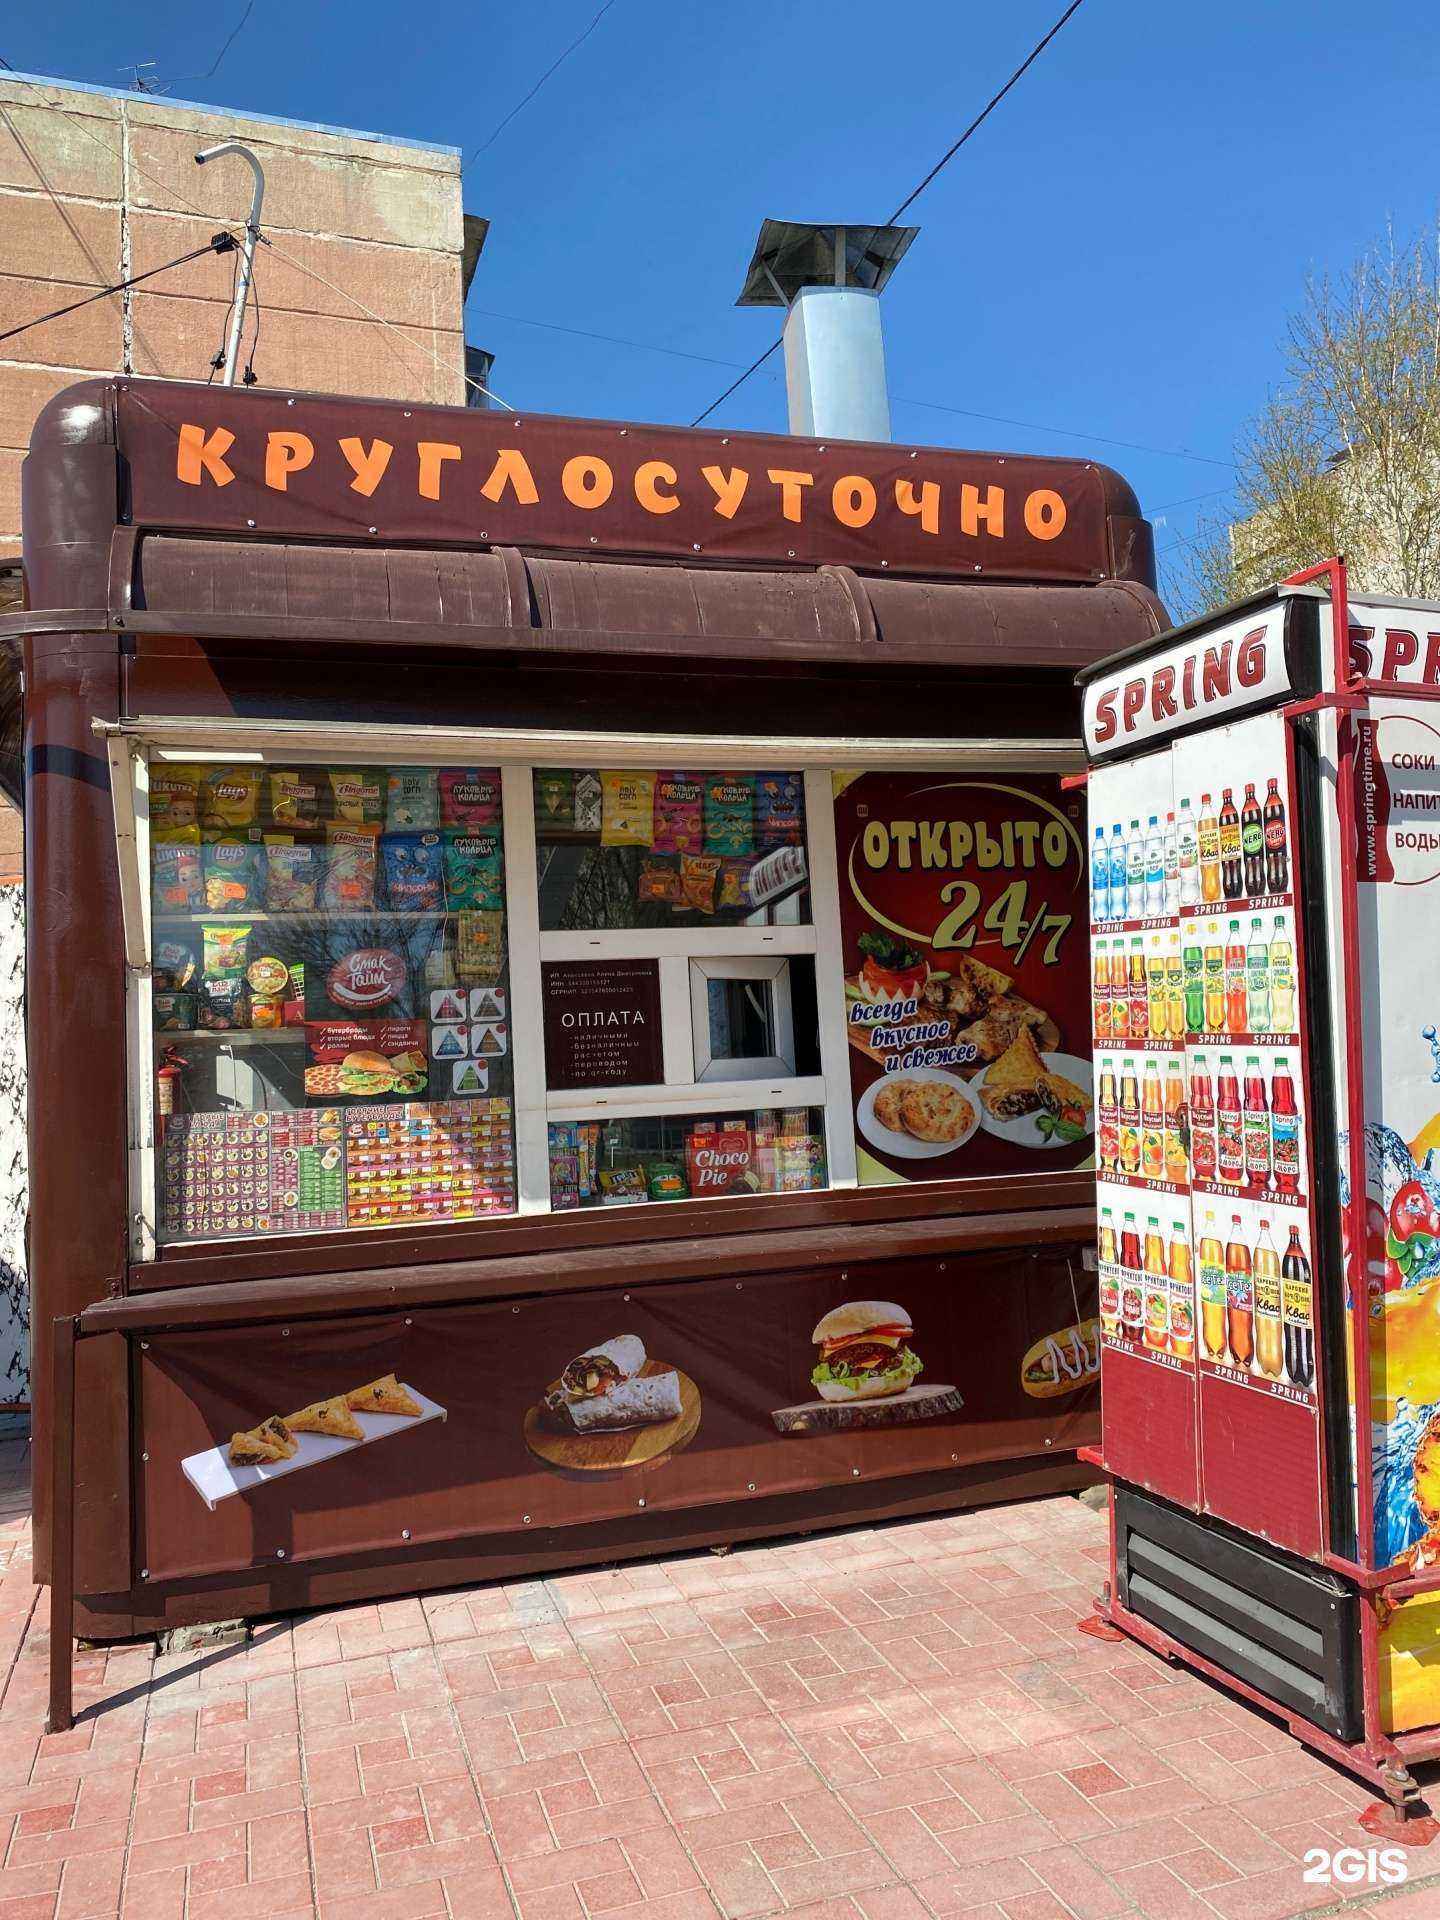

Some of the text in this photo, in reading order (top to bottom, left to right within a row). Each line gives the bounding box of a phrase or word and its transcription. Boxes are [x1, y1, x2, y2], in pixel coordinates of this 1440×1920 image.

[177, 423, 1067, 542] КРУГЛОСУТОЧНО
[1094, 625, 1268, 743] SPRING
[1392, 753, 1436, 771] СОКИ
[1361, 726, 1376, 877] www.springtime.ru
[863, 821, 1068, 869] ОТКРЫТО
[1194, 903, 1228, 916] SPRING
[1248, 895, 1285, 909] SPRING
[931, 881, 1072, 965] 24/7
[1096, 923, 1124, 934] SPRING
[1140, 917, 1171, 930] SPRING
[561, 1010, 645, 1028] ОПЛАТА
[1098, 1039, 1127, 1049] SPRING
[1144, 1041, 1174, 1051] SPRING
[1198, 1033, 1232, 1044] SPRING
[1253, 1034, 1291, 1045] SPRING
[695, 1149, 749, 1167] Choco
[696, 1168, 728, 1187] Pie
[1102, 1172, 1129, 1185] SPRING
[1146, 1180, 1177, 1193] SPRING
[1205, 1183, 1240, 1197] SPRING
[1260, 1190, 1298, 1206] SPRING
[1106, 1336, 1134, 1353] SPRING
[1151, 1351, 1182, 1369] SPRING
[1214, 1365, 1249, 1384] SPRING
[1270, 1383, 1309, 1403] SPRING
